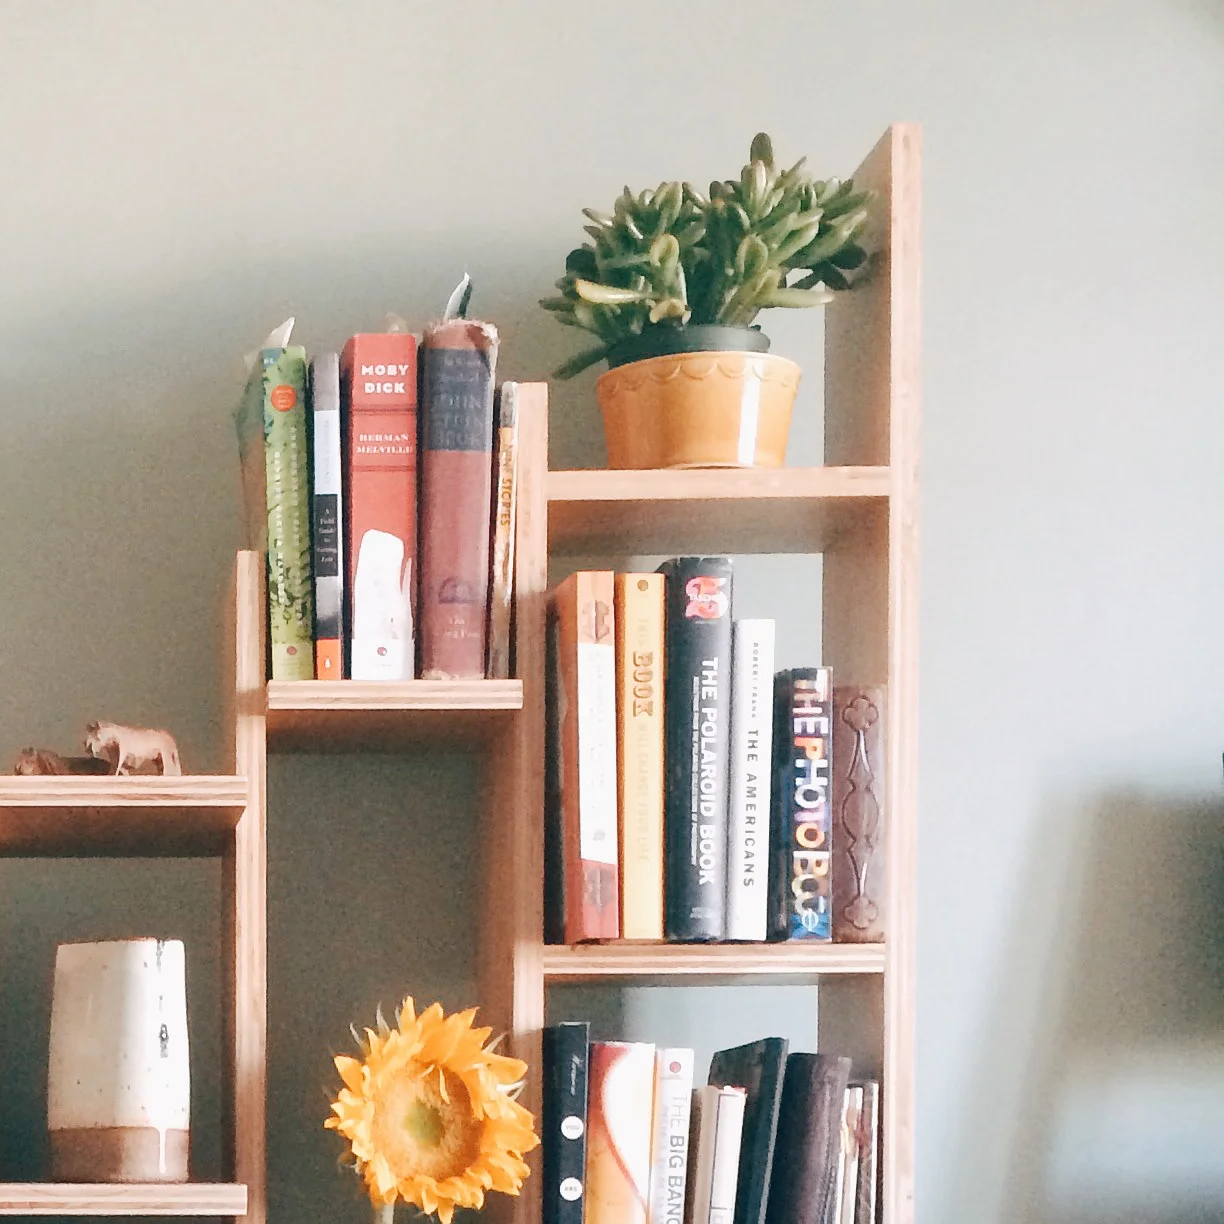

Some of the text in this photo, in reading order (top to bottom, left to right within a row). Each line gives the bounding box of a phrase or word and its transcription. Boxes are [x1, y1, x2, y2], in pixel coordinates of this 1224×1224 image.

[361, 365, 409, 376] MOBY
[364, 382, 405, 394] DICK
[633, 650, 654, 717] BOOK
[699, 657, 718, 885] THE POLAROID BOOK
[743, 729, 759, 888] THE AMERICANS
[670, 1093, 687, 1129] THE
[668, 1135, 686, 1169] BIG
